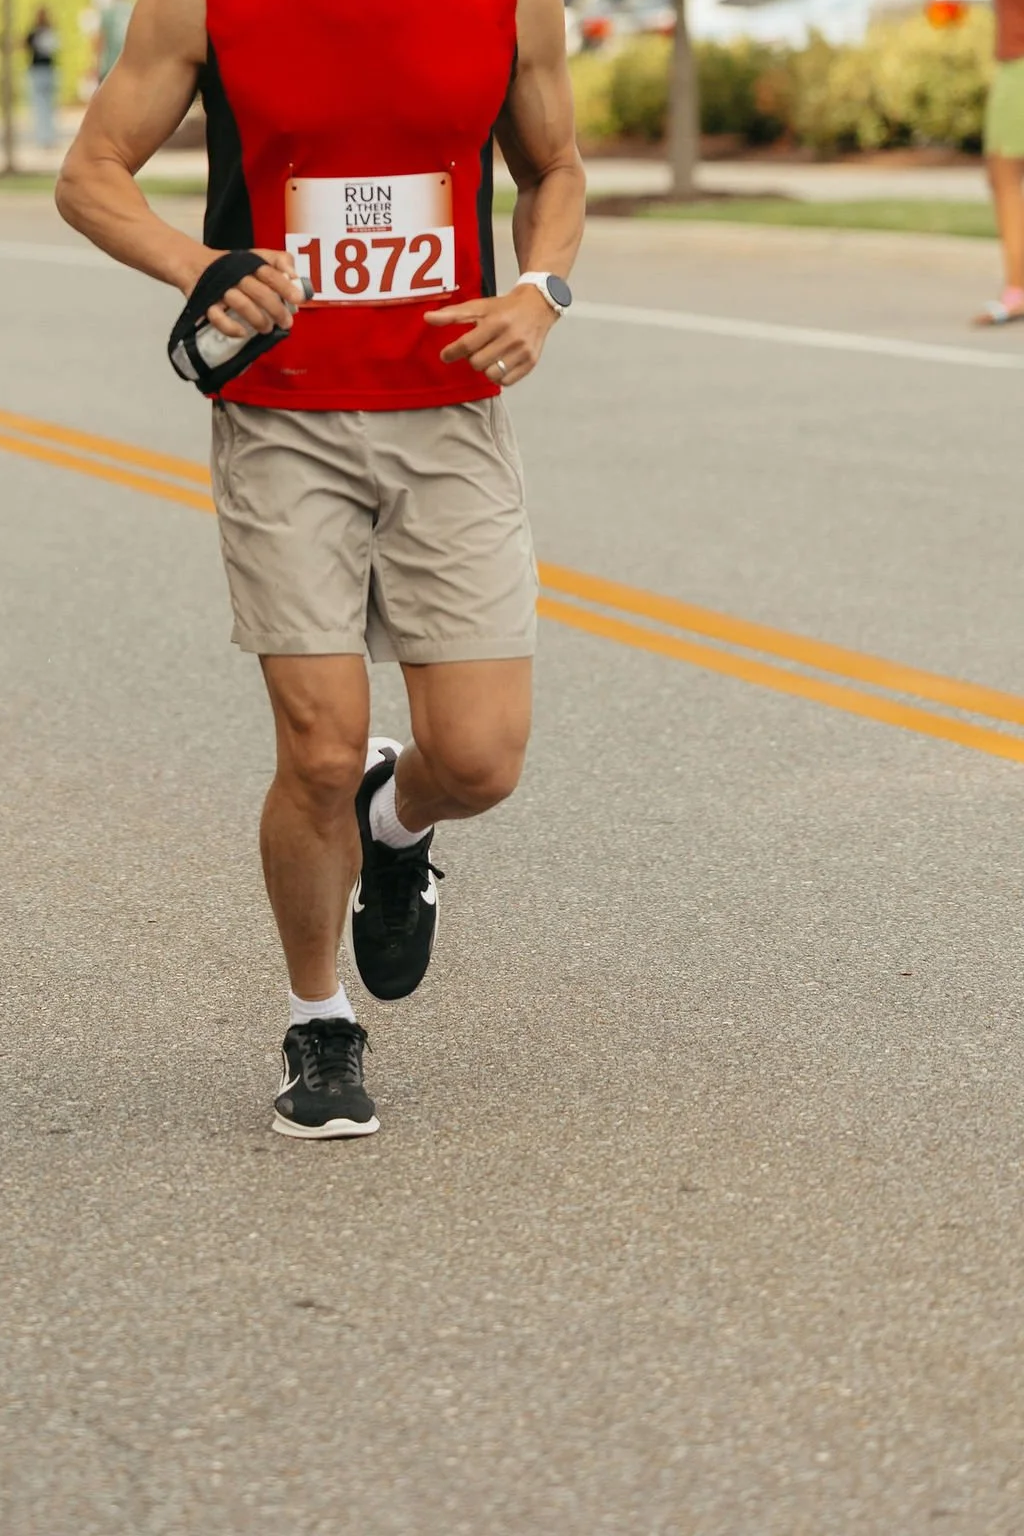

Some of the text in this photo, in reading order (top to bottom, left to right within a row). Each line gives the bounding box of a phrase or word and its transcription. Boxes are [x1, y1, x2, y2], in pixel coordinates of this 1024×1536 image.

[345, 185, 392, 203] RUN
[345, 203, 392, 212] 4 THEIR
[345, 212, 392, 226] LIVES
[297, 233, 443, 295] 1872
